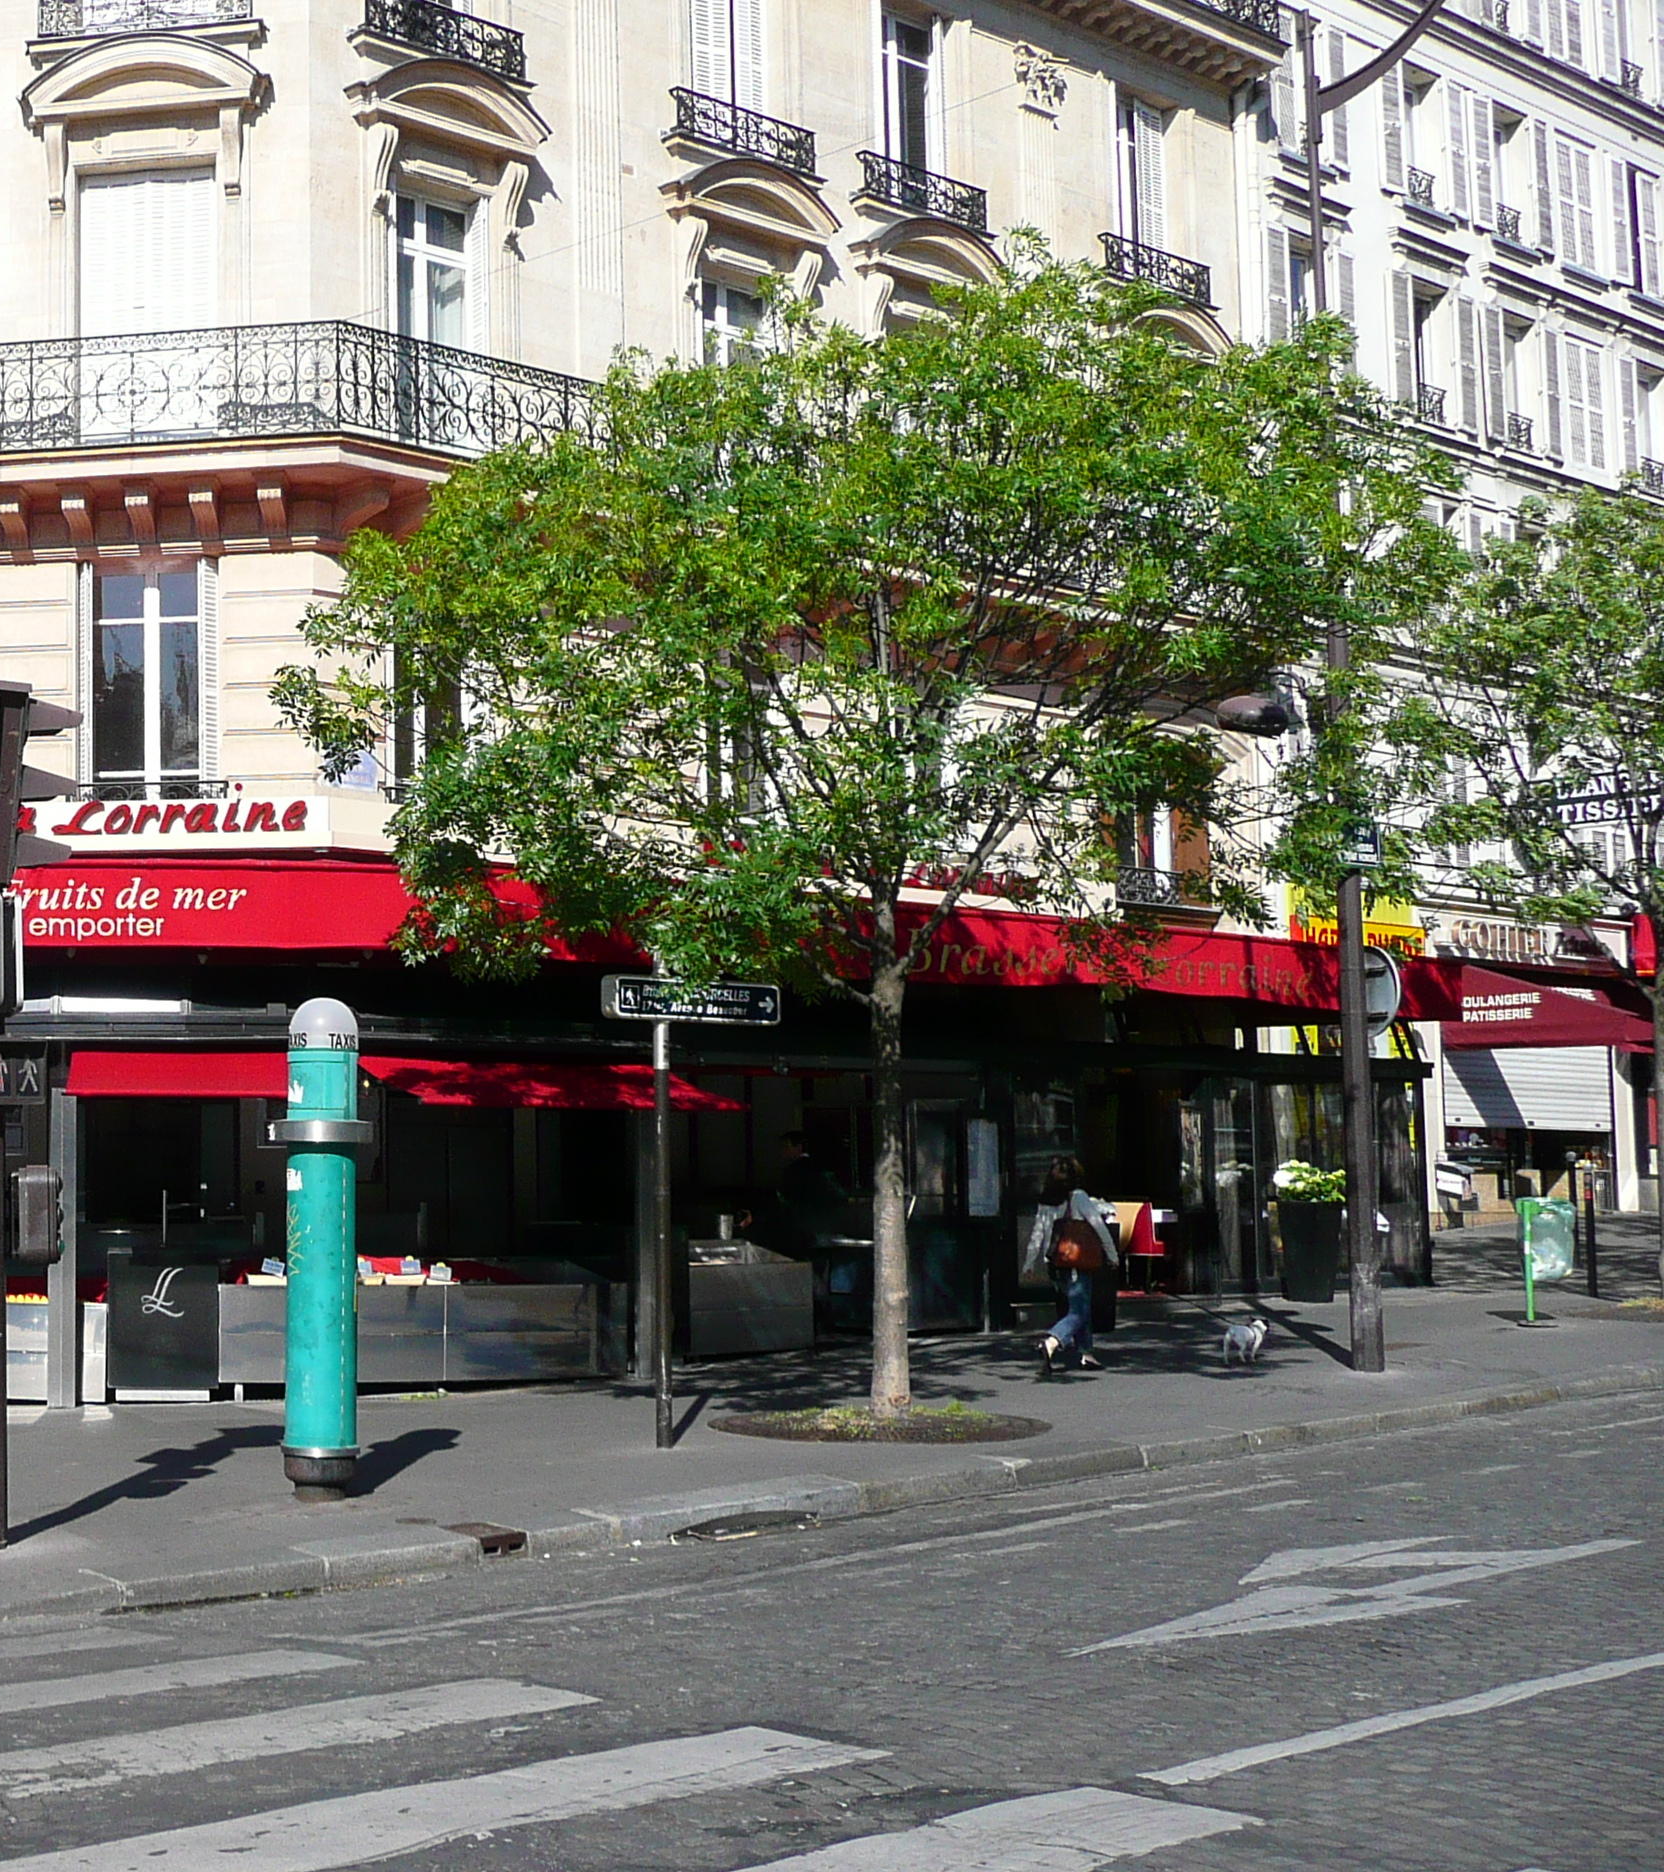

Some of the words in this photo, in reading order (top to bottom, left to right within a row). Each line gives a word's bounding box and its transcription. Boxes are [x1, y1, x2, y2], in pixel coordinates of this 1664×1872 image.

[51, 784, 308, 835] Lorraine
[115, 878, 160, 911] de
[173, 887, 247, 911] mer
[28, 914, 164, 942] emporter
[908, 928, 1116, 977] Brasser
[1151, 953, 1314, 999] orraine
[1462, 992, 1541, 1008] OULANGERIE
[1462, 1007, 1533, 1023] PATISSERIE
[289, 1033, 307, 1048] AXIS
[328, 1033, 356, 1049] TAXIS
